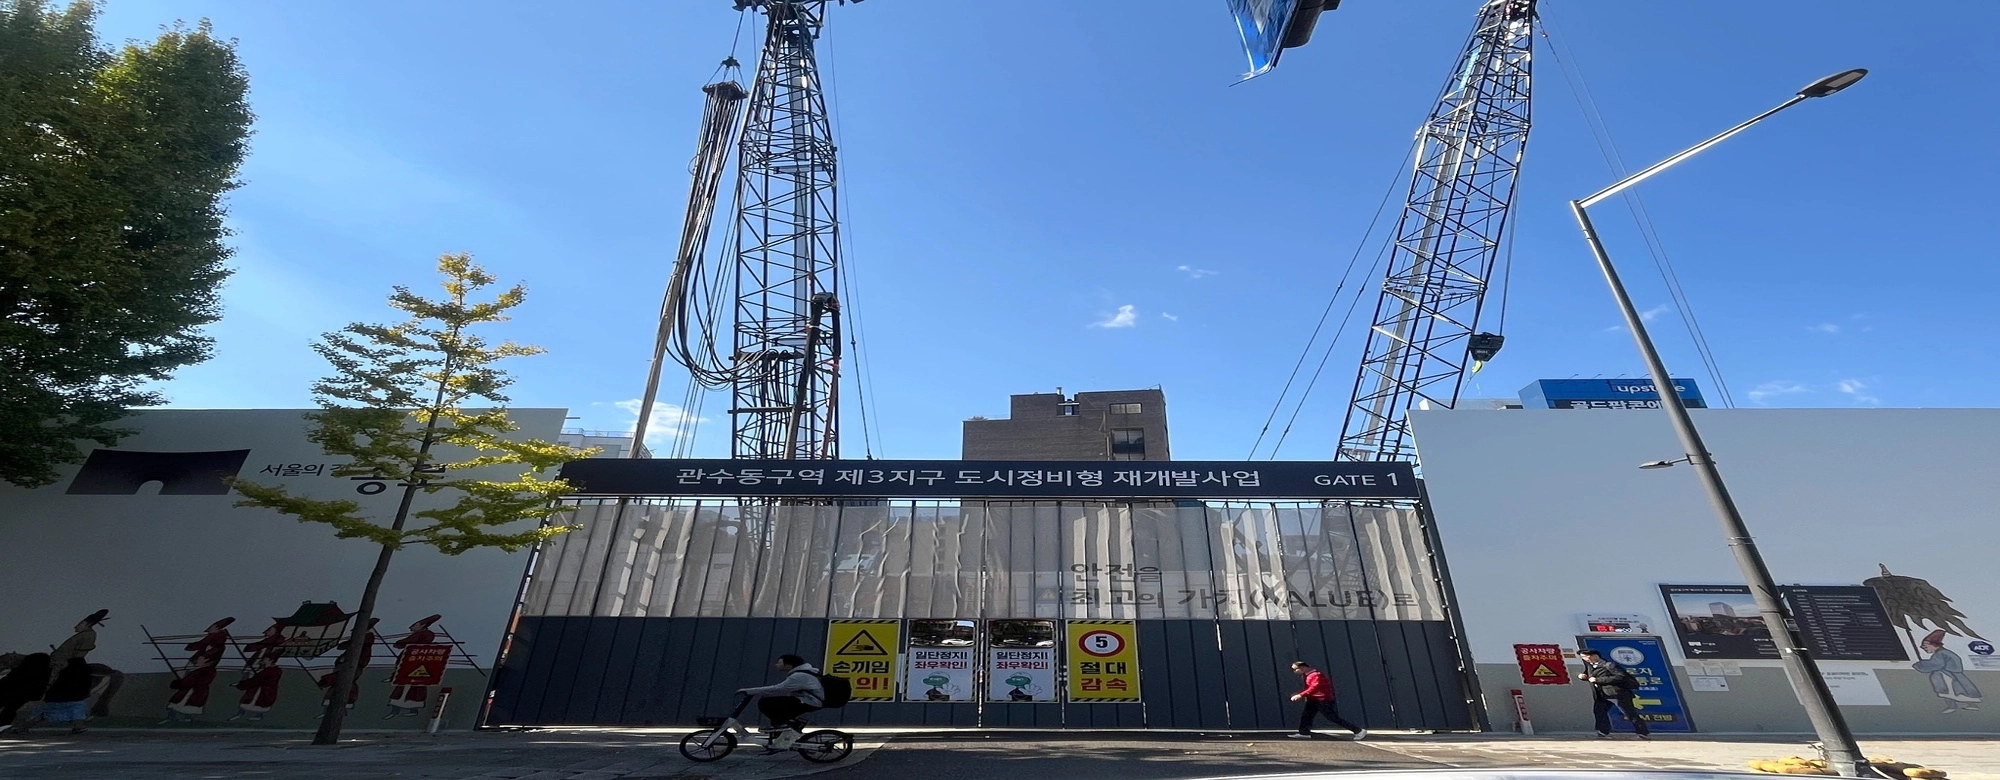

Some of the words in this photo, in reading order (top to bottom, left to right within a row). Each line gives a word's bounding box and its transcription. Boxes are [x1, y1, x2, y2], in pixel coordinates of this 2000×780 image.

[1617, 384, 1686, 394] upste
[260, 463, 324, 477] 서울의
[676, 469, 824, 485] 관수동구역
[836, 470, 946, 486] 제3지구
[955, 470, 1104, 487] 도시정비형
[1113, 470, 1261, 487] 재개발사업
[1314, 474, 1376, 486] GATE
[1386, 473, 1398, 486] 1
[1070, 563, 1164, 583] 안전을
[1070, 589, 1164, 609] 최고의
[1095, 635, 1108, 649] 5
[915, 651, 968, 660] 일단정지!
[996, 651, 1049, 660] 일단정지!
[832, 660, 890, 674] 손끼임
[914, 661, 968, 670] 좌우확인!
[996, 661, 1049, 670] 좌우확인!
[1080, 661, 1127, 675] 절대
[840, 676, 890, 690] 의!
[1080, 678, 1128, 692] 감속
